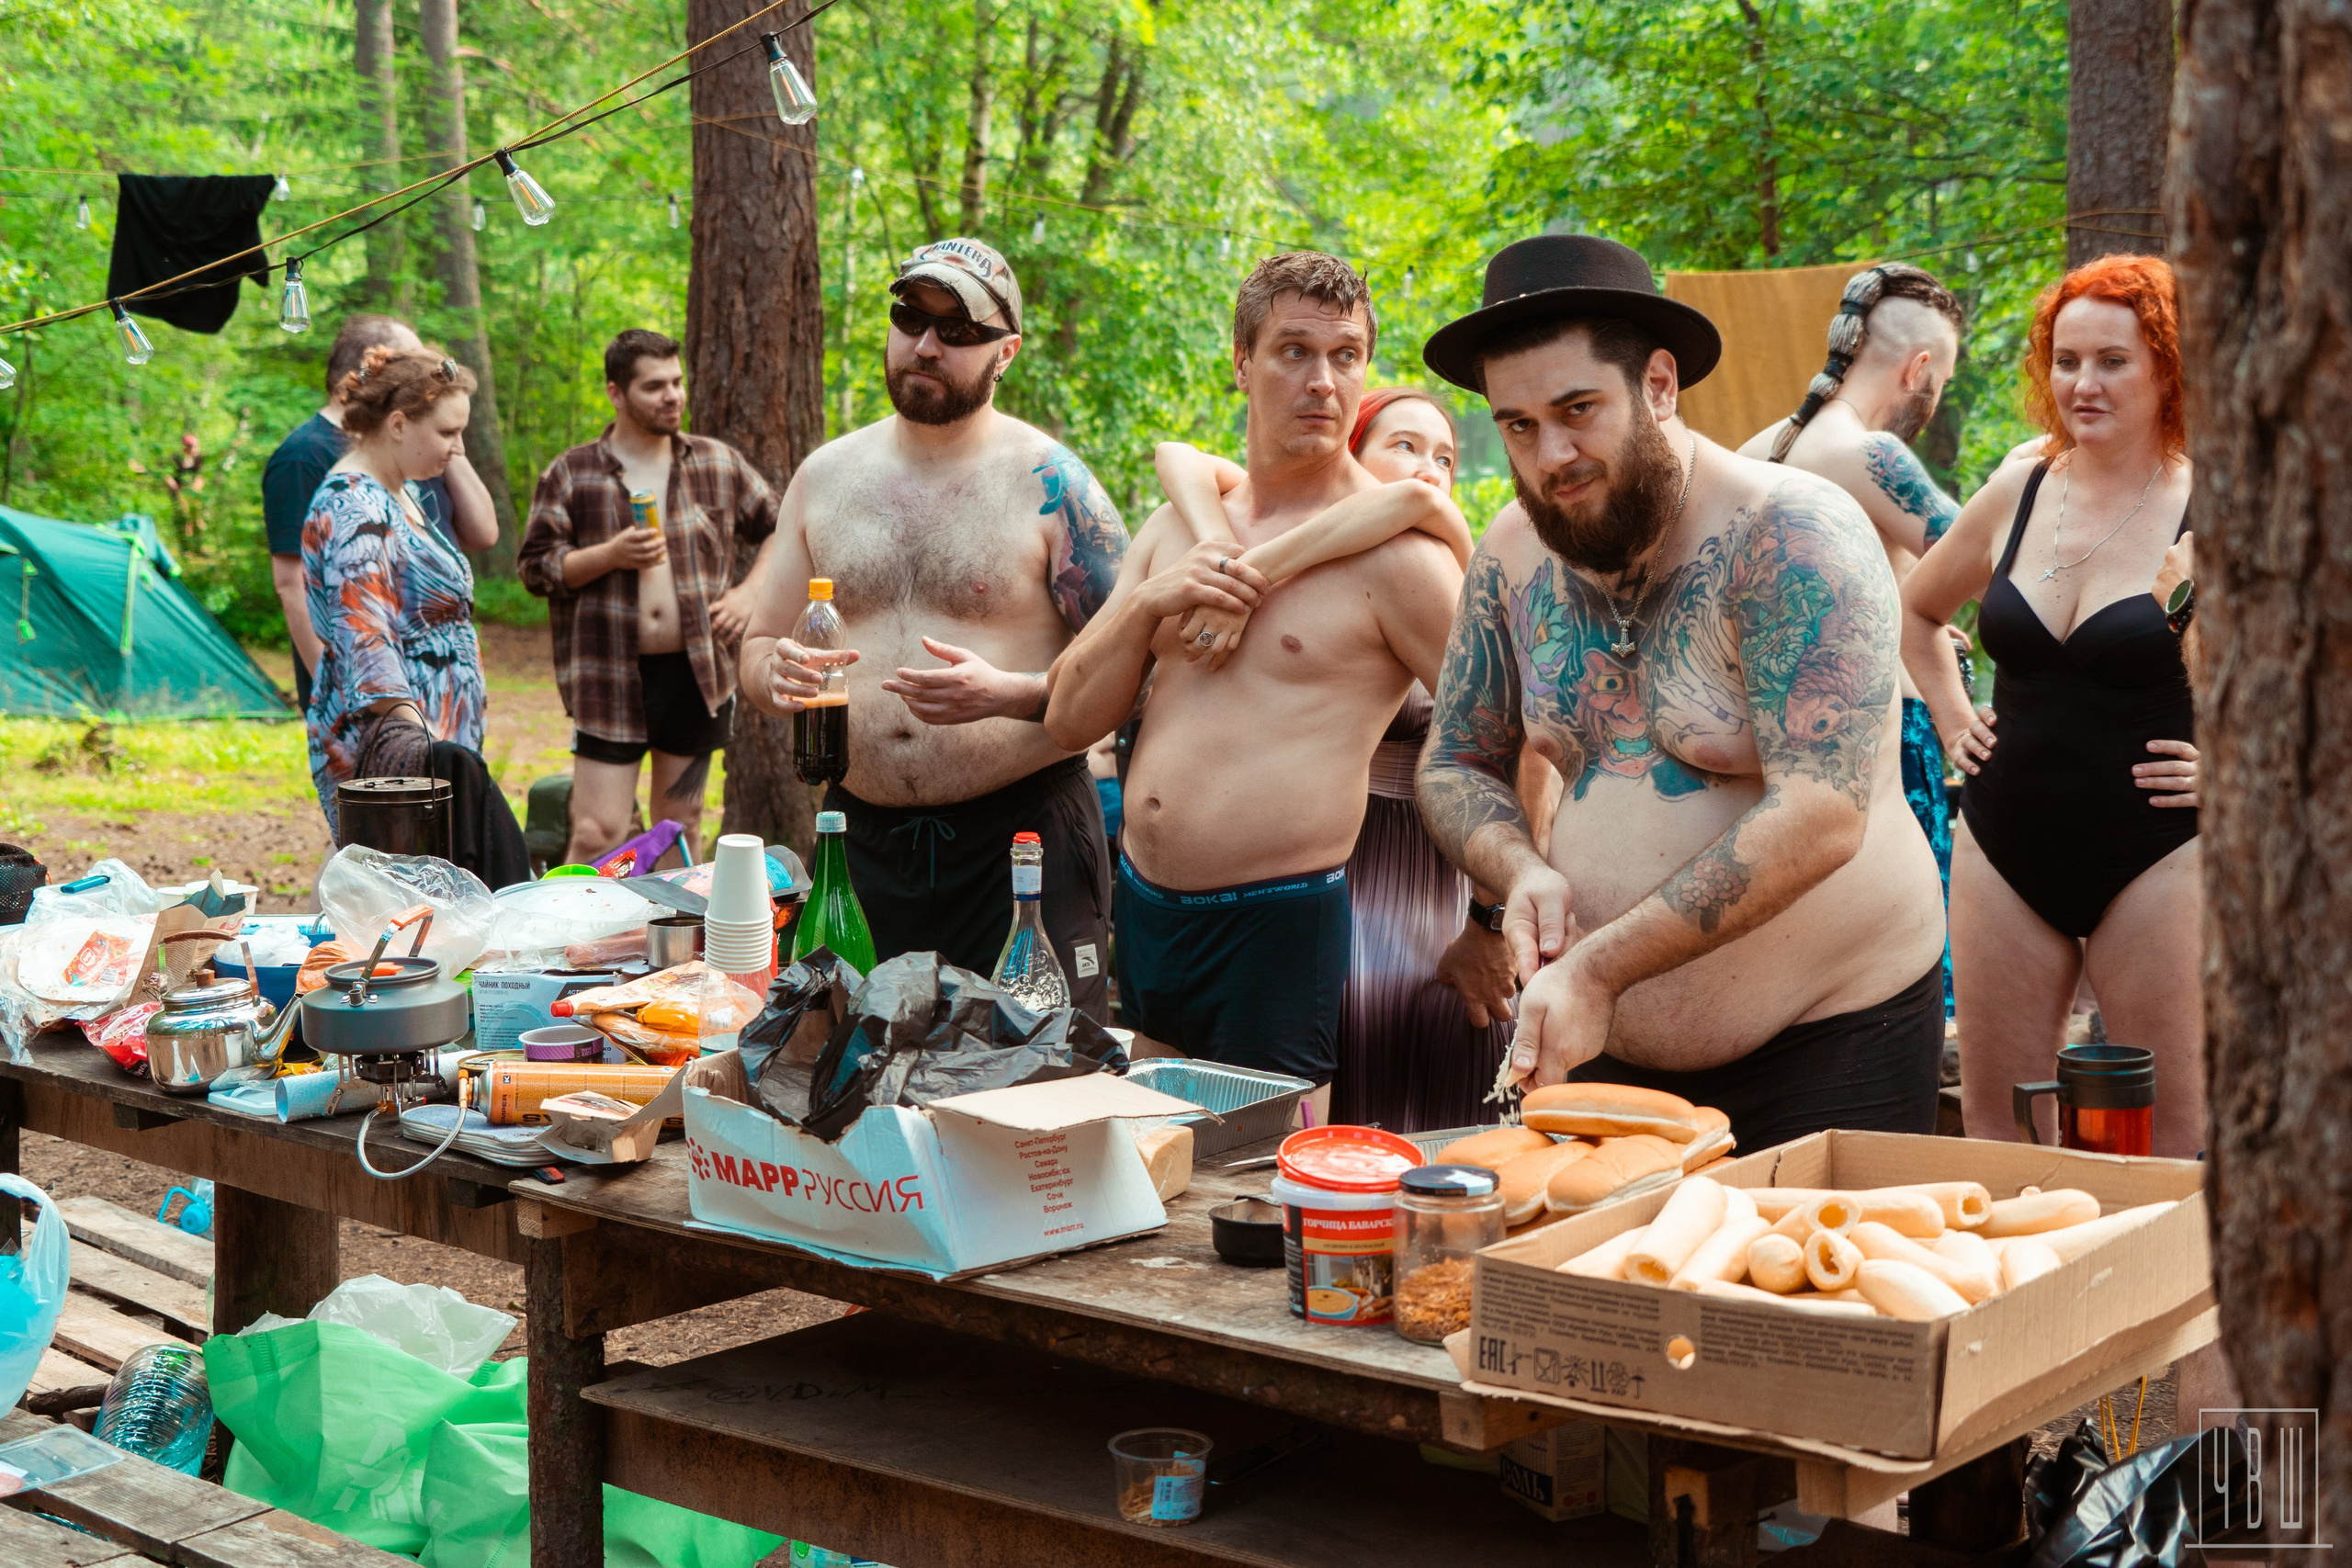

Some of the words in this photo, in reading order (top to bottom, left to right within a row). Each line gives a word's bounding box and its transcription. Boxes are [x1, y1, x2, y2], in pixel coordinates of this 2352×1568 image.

[478, 981, 499, 989] ЧАЙНИК
[501, 981, 531, 990] ПОХОДНЫЙ
[1014, 1134, 1067, 1149] Санкт-Петербург
[1019, 1145, 1068, 1159] Ростов-на-Дону
[1035, 1158, 1058, 1168] Самара
[1028, 1168, 1070, 1181] Новосибирск
[1030, 1178, 1074, 1192] Екатеринбург
[1046, 1192, 1064, 1201] Сочи
[1043, 1201, 1073, 1213] Воронеж
[1043, 1223, 1084, 1236] www.marr.ru
[1303, 1217, 1347, 1231] ГОРЧИЦА
